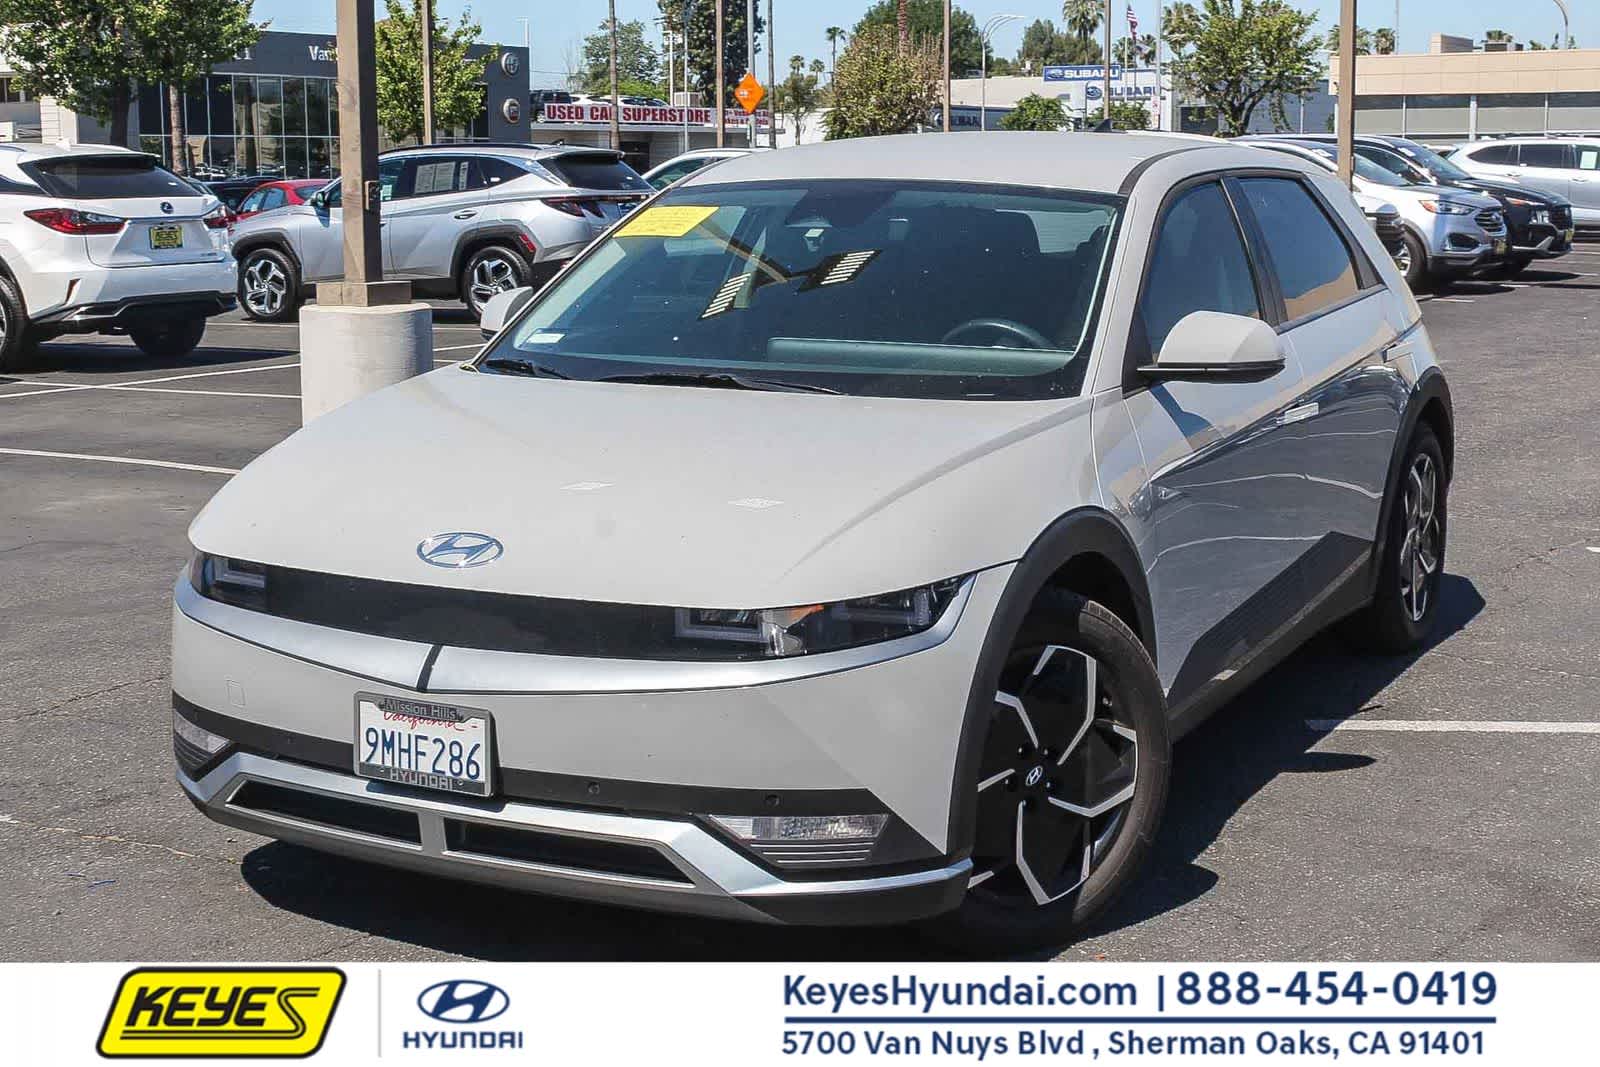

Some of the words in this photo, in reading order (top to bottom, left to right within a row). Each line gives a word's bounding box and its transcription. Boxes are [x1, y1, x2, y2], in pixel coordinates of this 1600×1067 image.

[1109, 86, 1157, 96] UBAR
[547, 105, 584, 120] USED
[590, 106, 612, 121] CA
[623, 108, 711, 123] SUPERSTORE
[384, 699, 427, 716] Mission
[431, 704, 457, 720] Hills
[365, 727, 481, 781] 9MHF286
[390, 767, 454, 790] HYUNDAI
